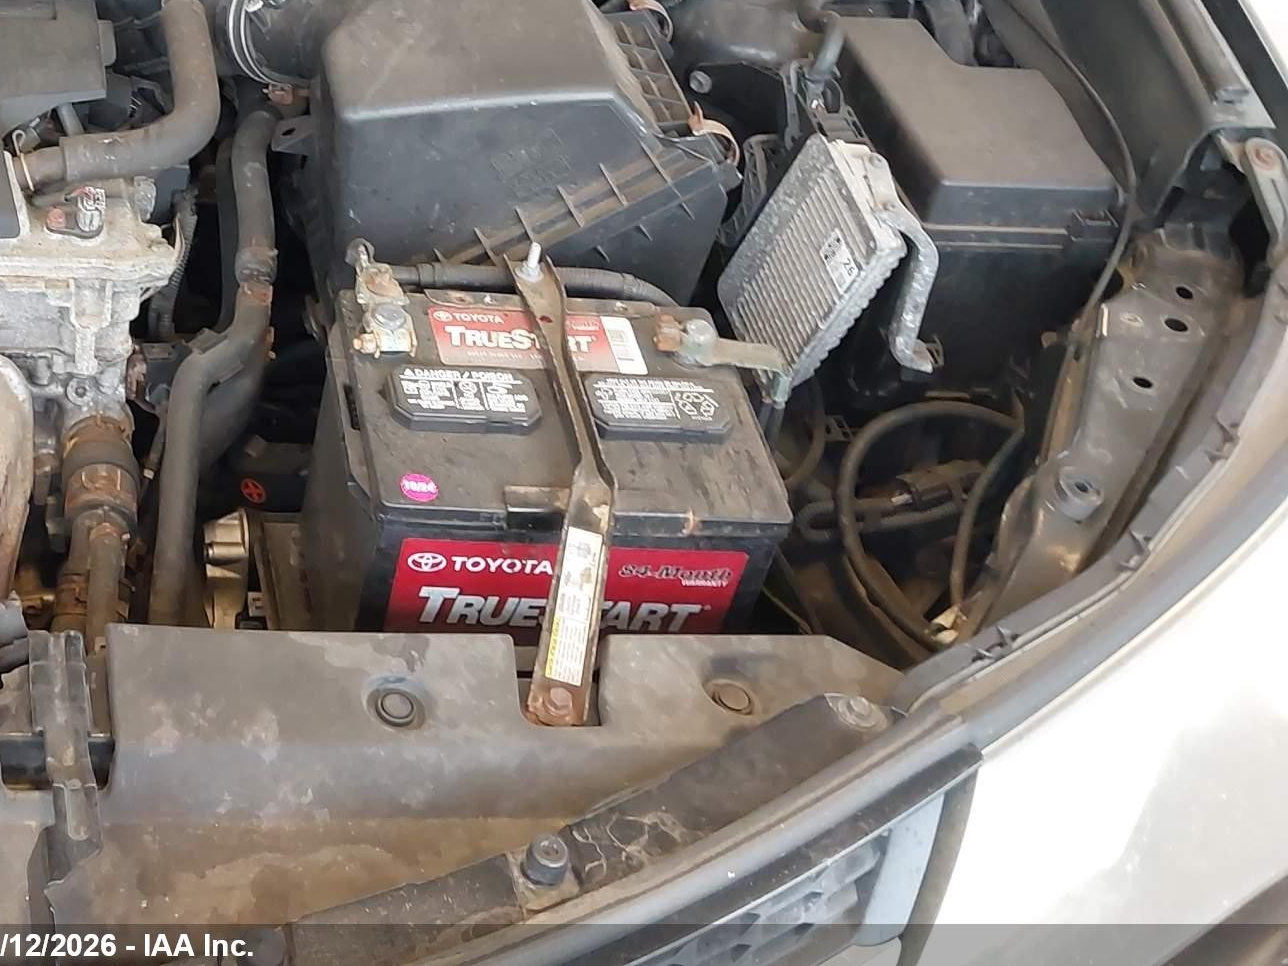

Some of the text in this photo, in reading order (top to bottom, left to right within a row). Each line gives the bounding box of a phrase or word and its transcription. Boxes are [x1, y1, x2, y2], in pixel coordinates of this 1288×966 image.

[453, 312, 505, 324] TOYOTA
[416, 368, 460, 379] DANGER
[471, 370, 513, 382] POISON
[451, 555, 553, 575] TOYOTA
